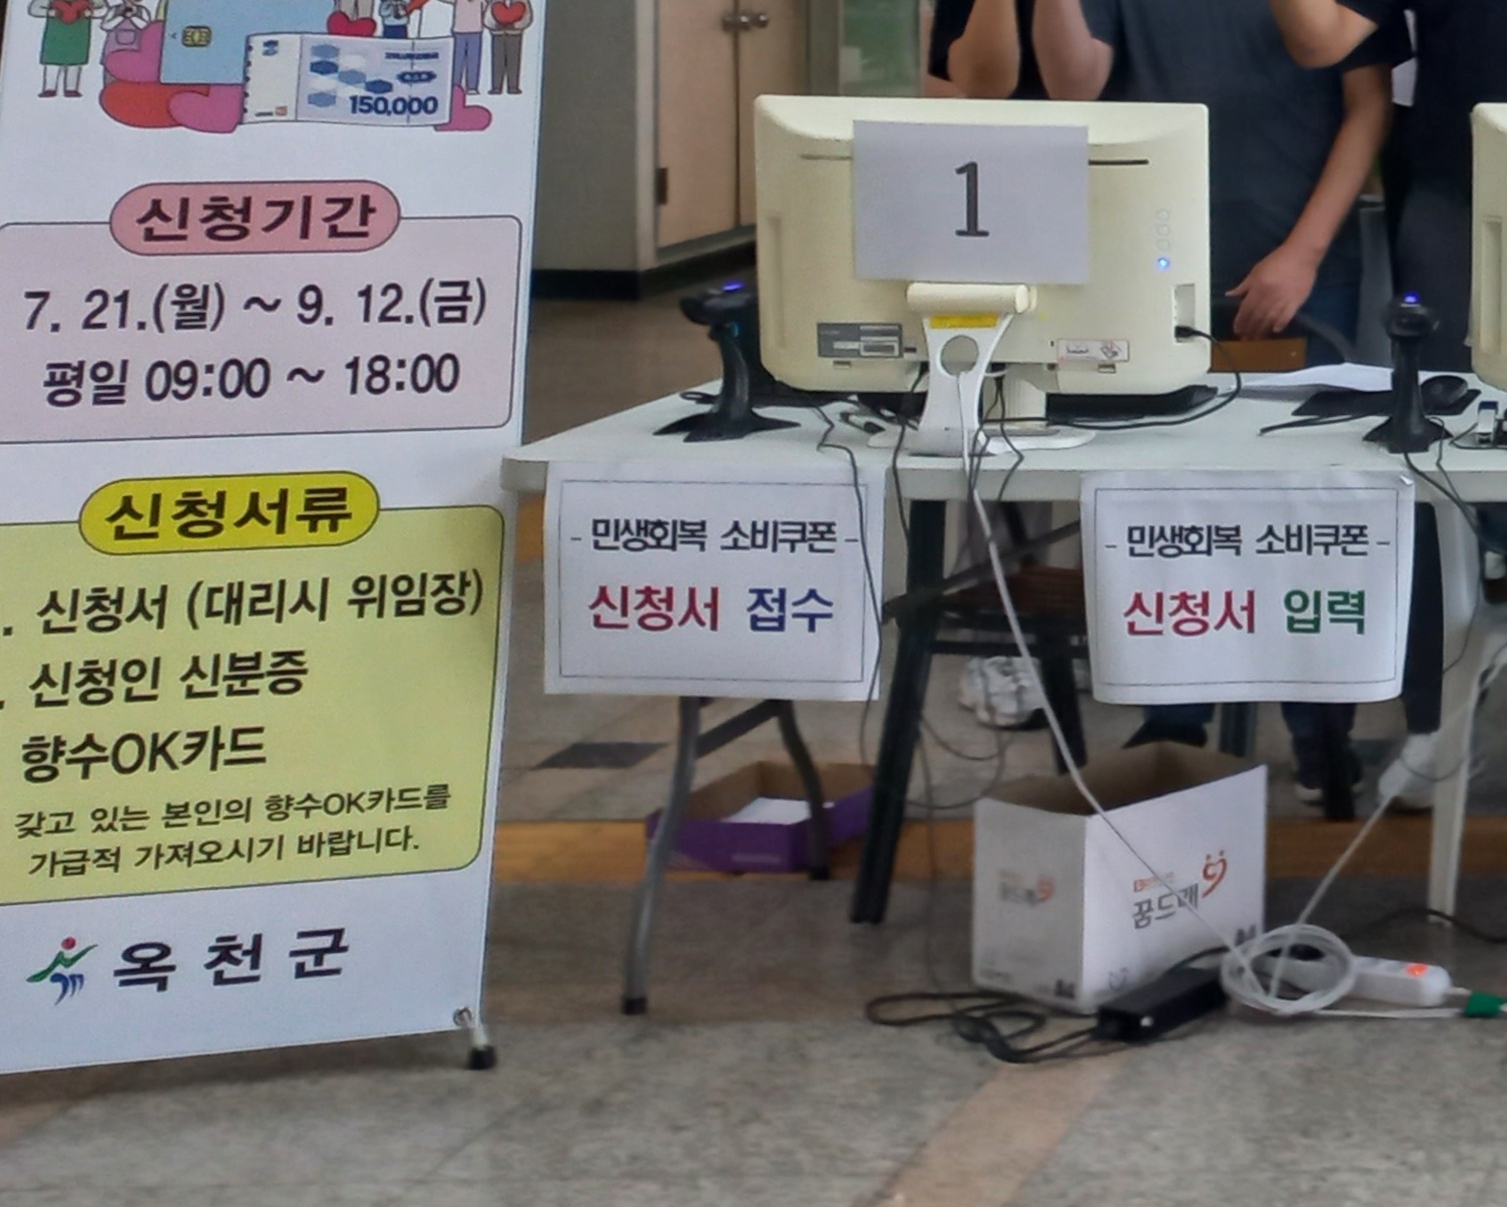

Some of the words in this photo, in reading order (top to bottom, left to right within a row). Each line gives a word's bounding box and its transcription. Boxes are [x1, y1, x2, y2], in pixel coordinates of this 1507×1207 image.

[349, 95, 439, 117] 150,000
[136, 193, 377, 243] 신청기간
[955, 161, 990, 237] 1
[42, 359, 130, 408] 평일
[145, 356, 270, 400] 09:00
[345, 352, 460, 394] 18:00
[105, 486, 352, 541] 신청서류
[592, 518, 707, 553] 민생회복
[720, 520, 837, 553] 소비쿠폰
[1127, 524, 1242, 558] 민생회복
[1255, 524, 1369, 557] 소비쿠폰
[36, 582, 168, 635] 신청서
[187, 577, 330, 629] (대리시
[348, 568, 484, 619] 위임장)
[589, 585, 719, 632] 신청서
[747, 587, 834, 633] 접수
[1123, 589, 1255, 636] 신청서
[1284, 589, 1365, 635] 입력
[29, 654, 160, 708] 신청인
[179, 650, 308, 699] 신분증
[21, 724, 267, 782] 향수OK카드
[15, 808, 75, 838] 갖고
[91, 803, 150, 834] 있는
[161, 798, 252, 829] 본인의
[264, 783, 451, 822] 향수OK카드를
[28, 846, 121, 878] 가급적
[134, 833, 285, 869] 가져오시기
[296, 825, 419, 857] 바랍니다.
